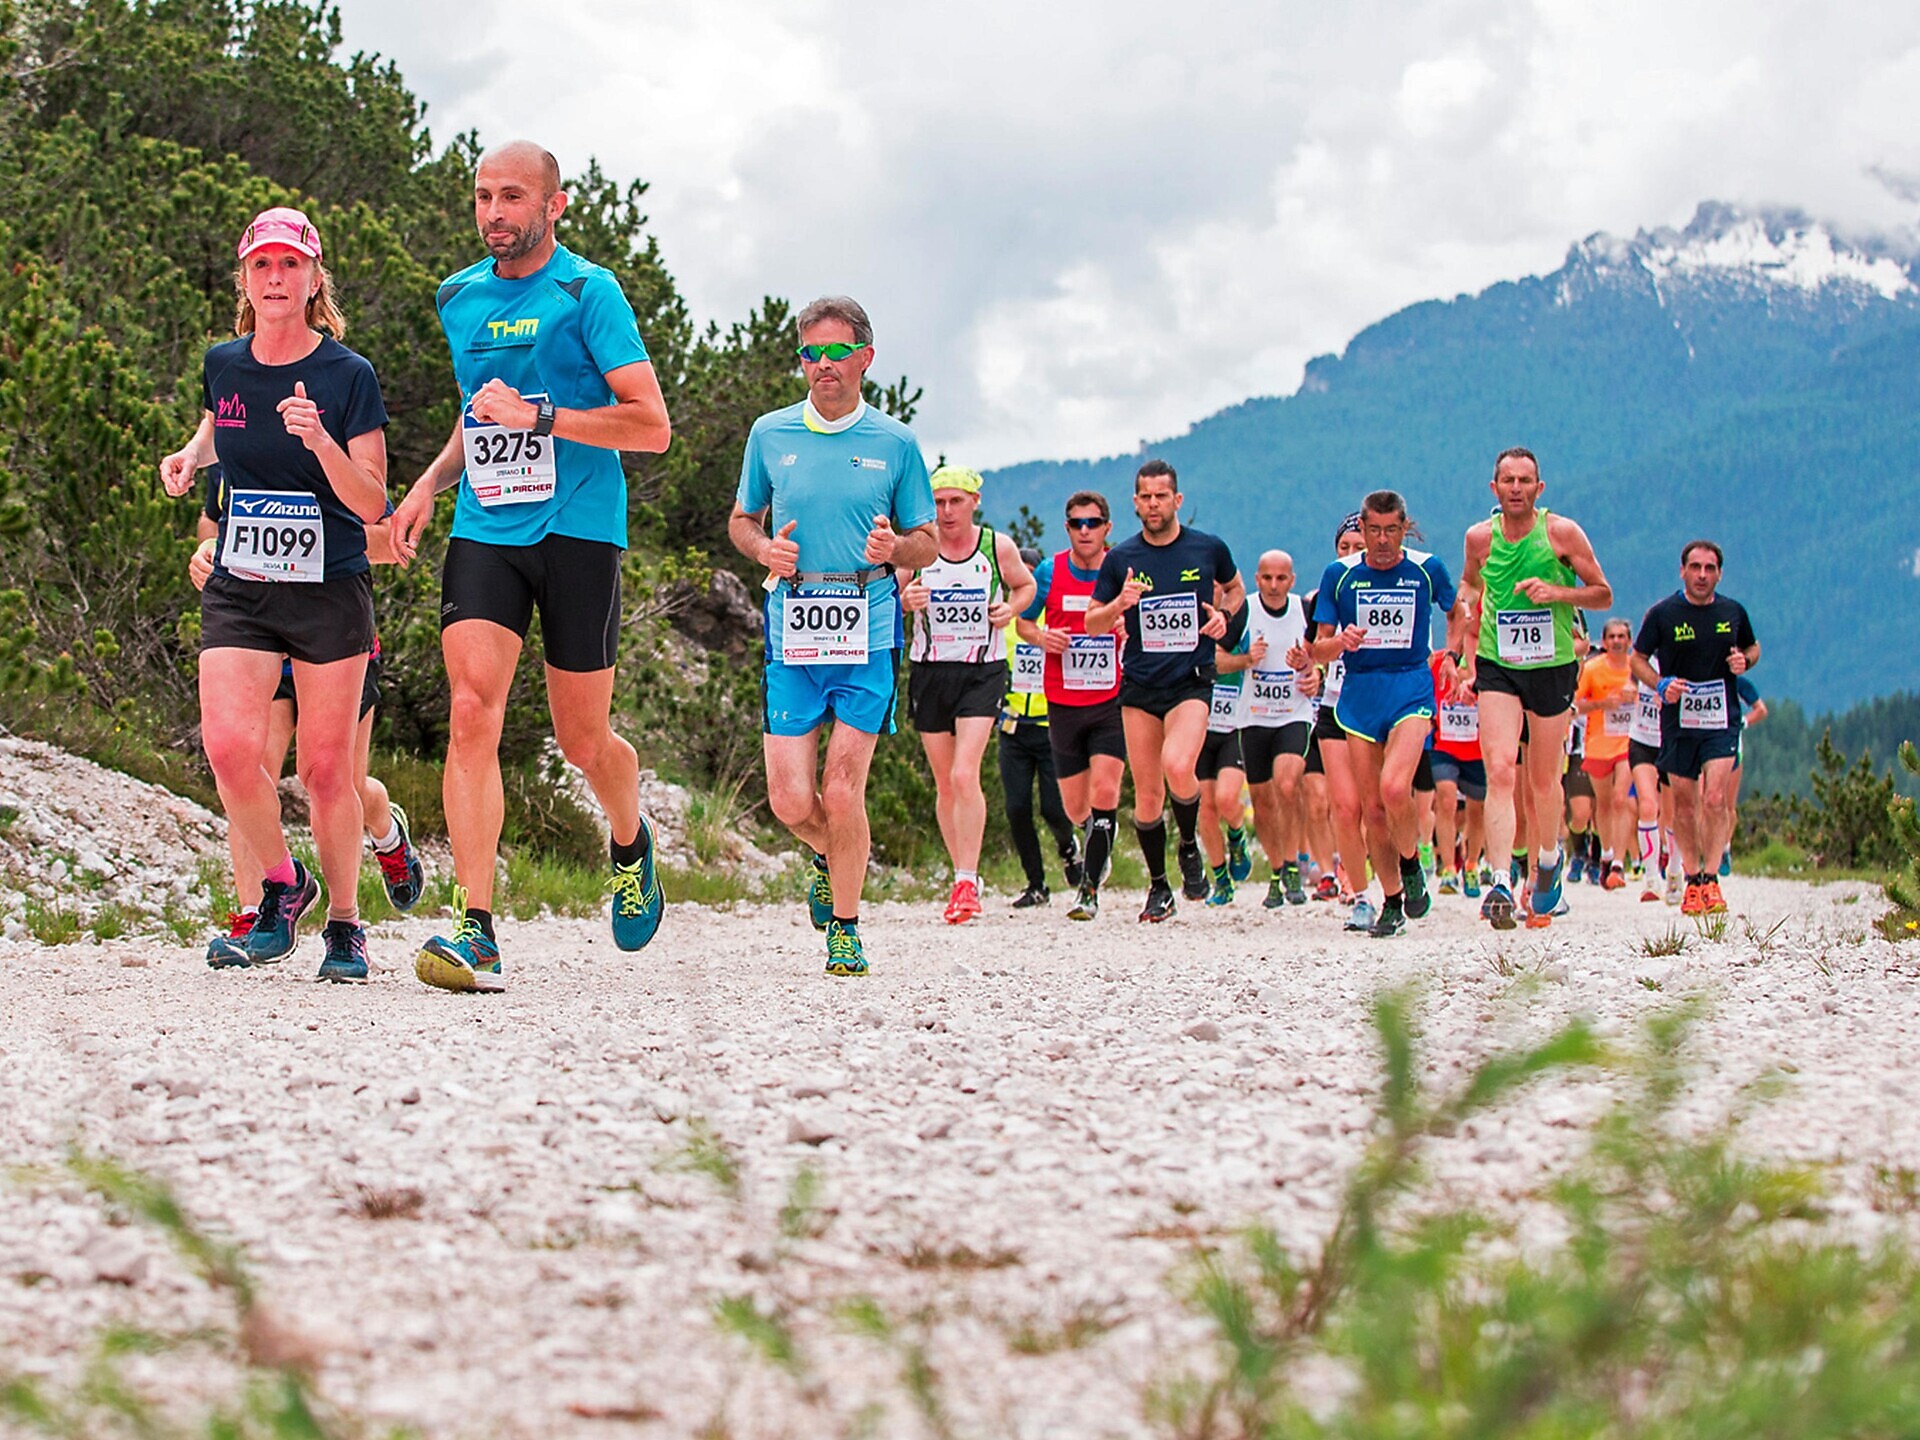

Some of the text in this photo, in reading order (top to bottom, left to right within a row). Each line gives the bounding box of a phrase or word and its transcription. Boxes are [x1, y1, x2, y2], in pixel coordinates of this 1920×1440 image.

[488, 319, 539, 339] THM
[474, 432, 542, 466] 3275
[512, 484, 552, 494] PIRCHER
[232, 526, 317, 558] F1099
[790, 605, 861, 631] 3009
[936, 607, 982, 623] 3236
[1146, 613, 1192, 630] 3368
[1368, 609, 1403, 626] 886
[1511, 627, 1541, 645] 718
[1071, 653, 1108, 669] 1773
[1254, 684, 1291, 699] 3405
[1685, 696, 1721, 711] 2843
[1448, 714, 1470, 726] 935
